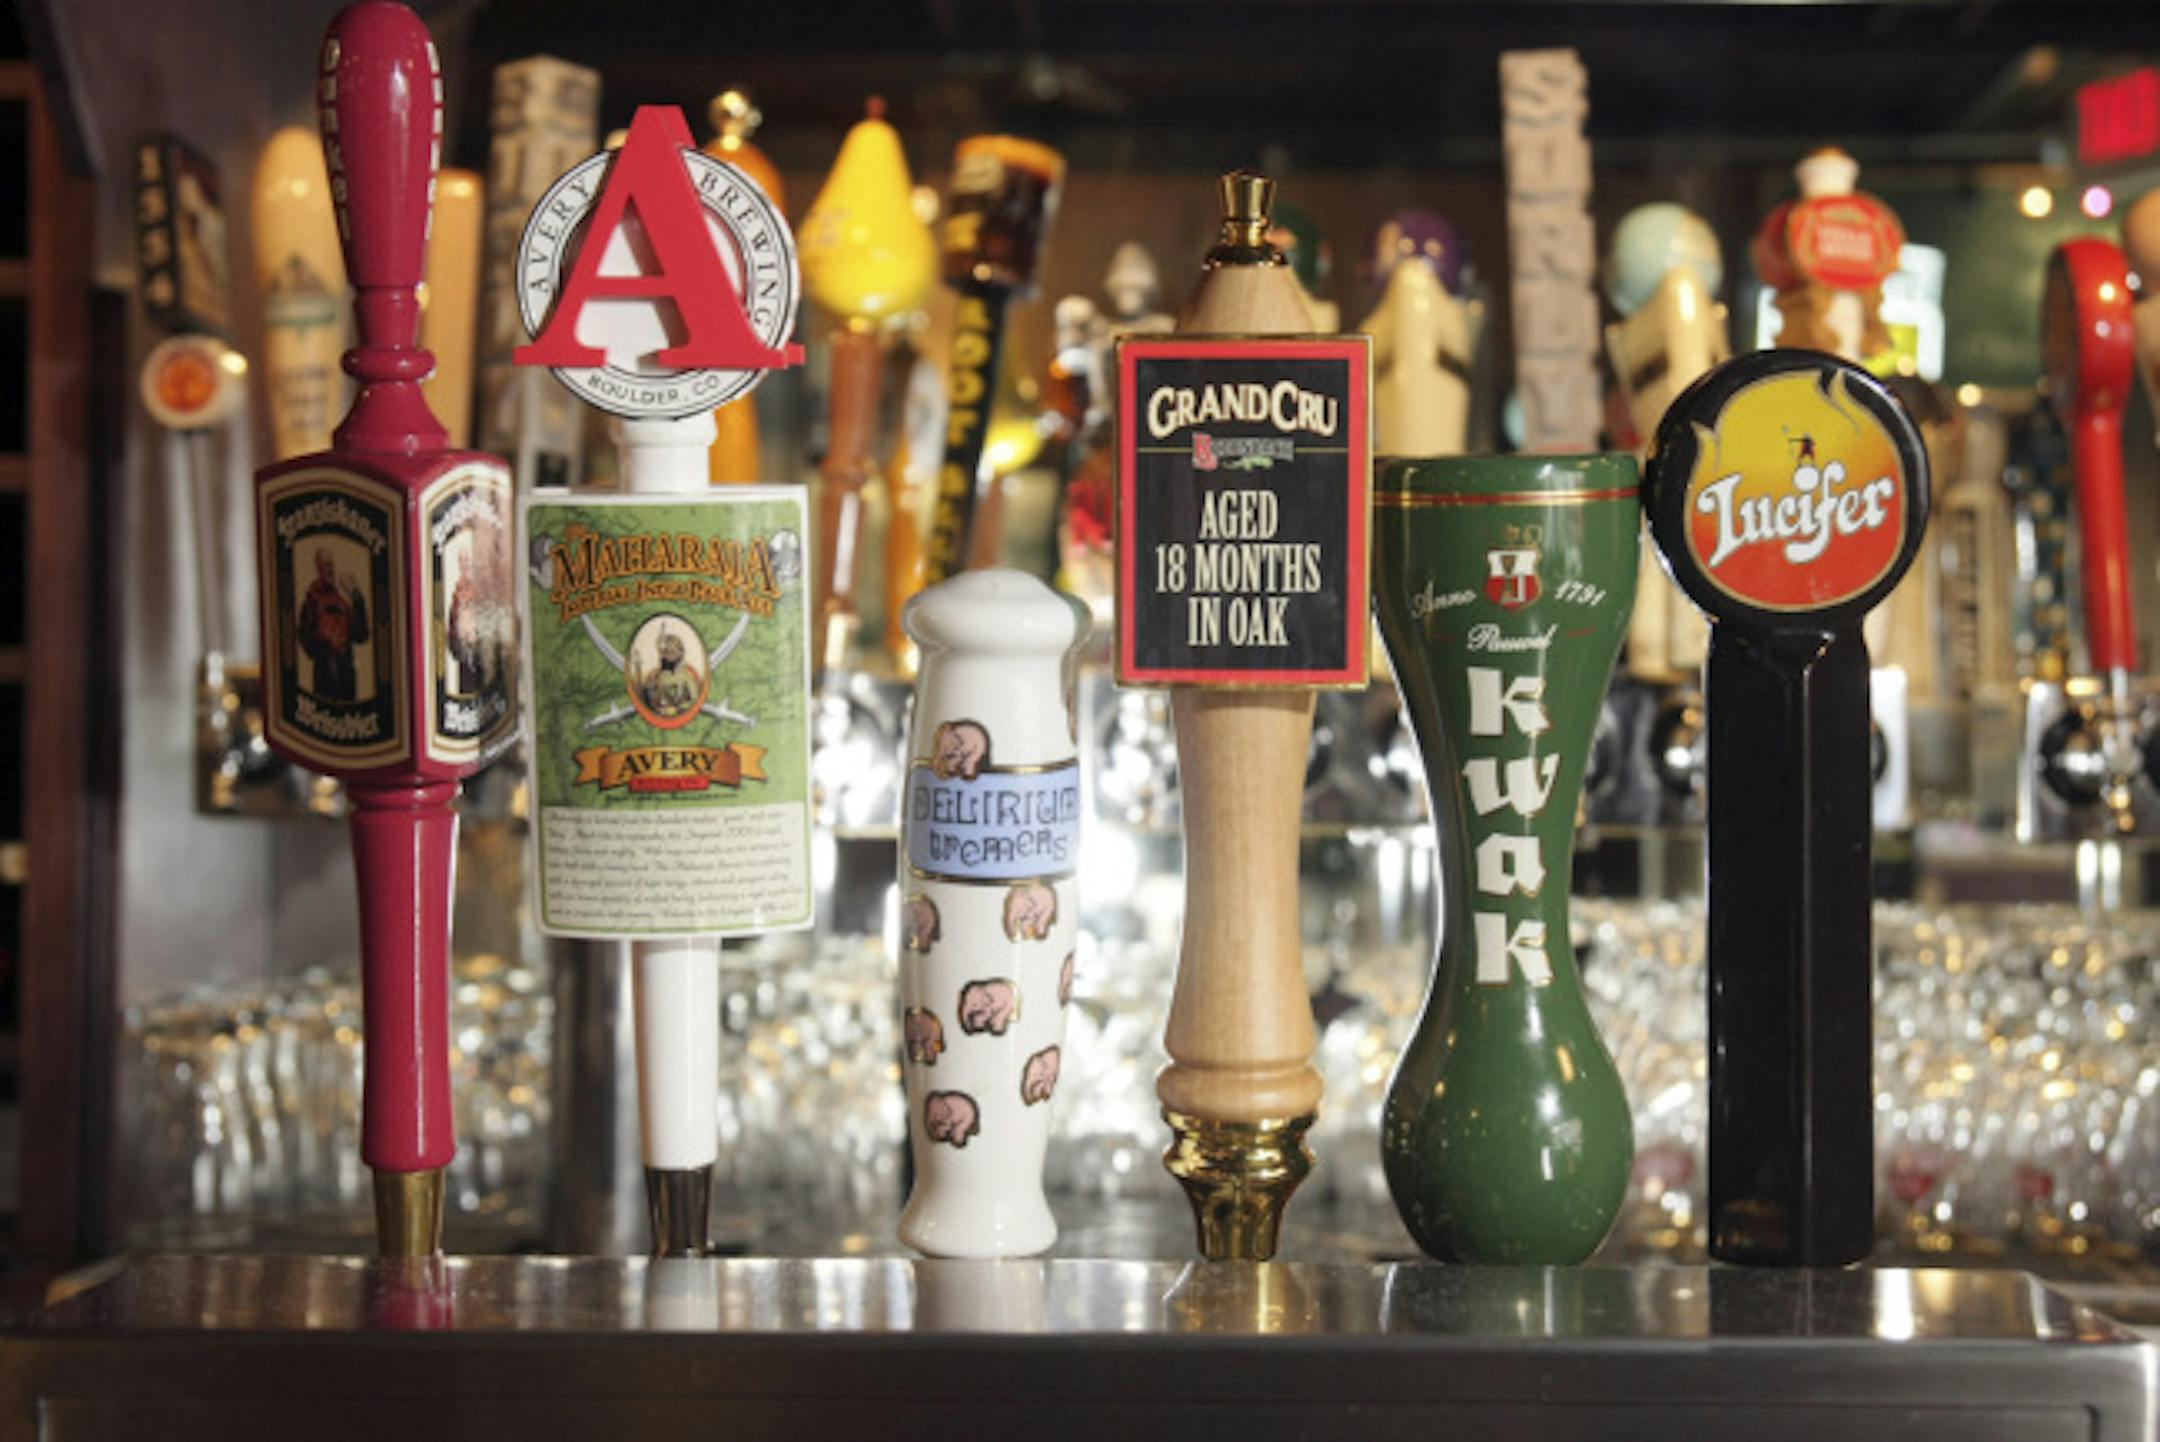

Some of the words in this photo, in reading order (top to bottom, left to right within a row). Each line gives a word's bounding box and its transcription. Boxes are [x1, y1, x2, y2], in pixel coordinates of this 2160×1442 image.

[530, 173, 594, 293] AVERY
[699, 171, 778, 327] BREWING
[1147, 383, 1269, 438] GRAND
[1270, 380, 1338, 438] CRU
[1198, 489, 1279, 539] AGED
[1696, 461, 1894, 568] Lucifer
[552, 532, 781, 600] MAHARAJA
[1155, 543, 1187, 593] 18
[1194, 543, 1322, 593] MONTHS
[1187, 597, 1222, 646] IN
[1227, 597, 1290, 646] OAK
[618, 749, 720, 779] AVERY
